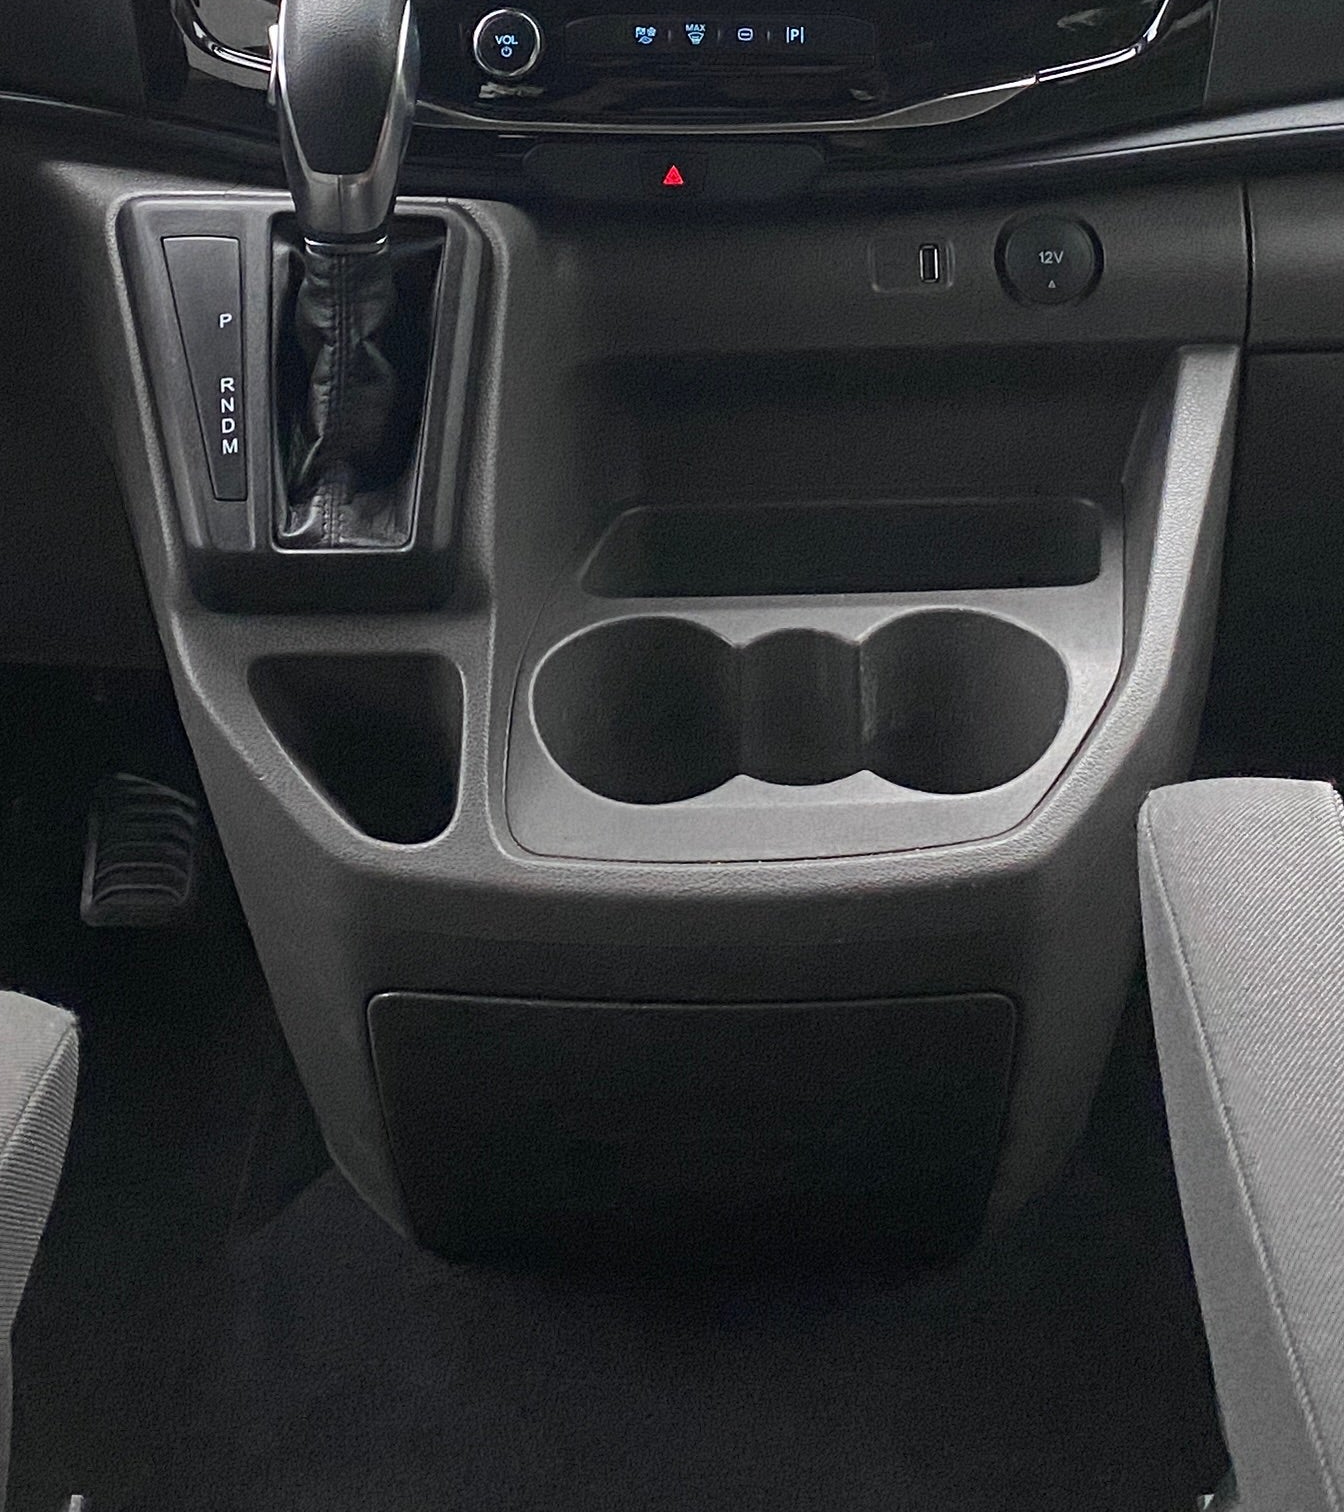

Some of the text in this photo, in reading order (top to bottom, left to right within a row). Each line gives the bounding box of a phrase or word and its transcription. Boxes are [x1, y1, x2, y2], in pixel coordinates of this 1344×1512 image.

[685, 24, 706, 32] MAX
[495, 35, 518, 45] VOL
[1038, 251, 1064, 264] 12V
[219, 313, 232, 328] P
[220, 377, 235, 392] R
[220, 398, 234, 412] N
[221, 418, 235, 433] D
[222, 439, 238, 455] M
